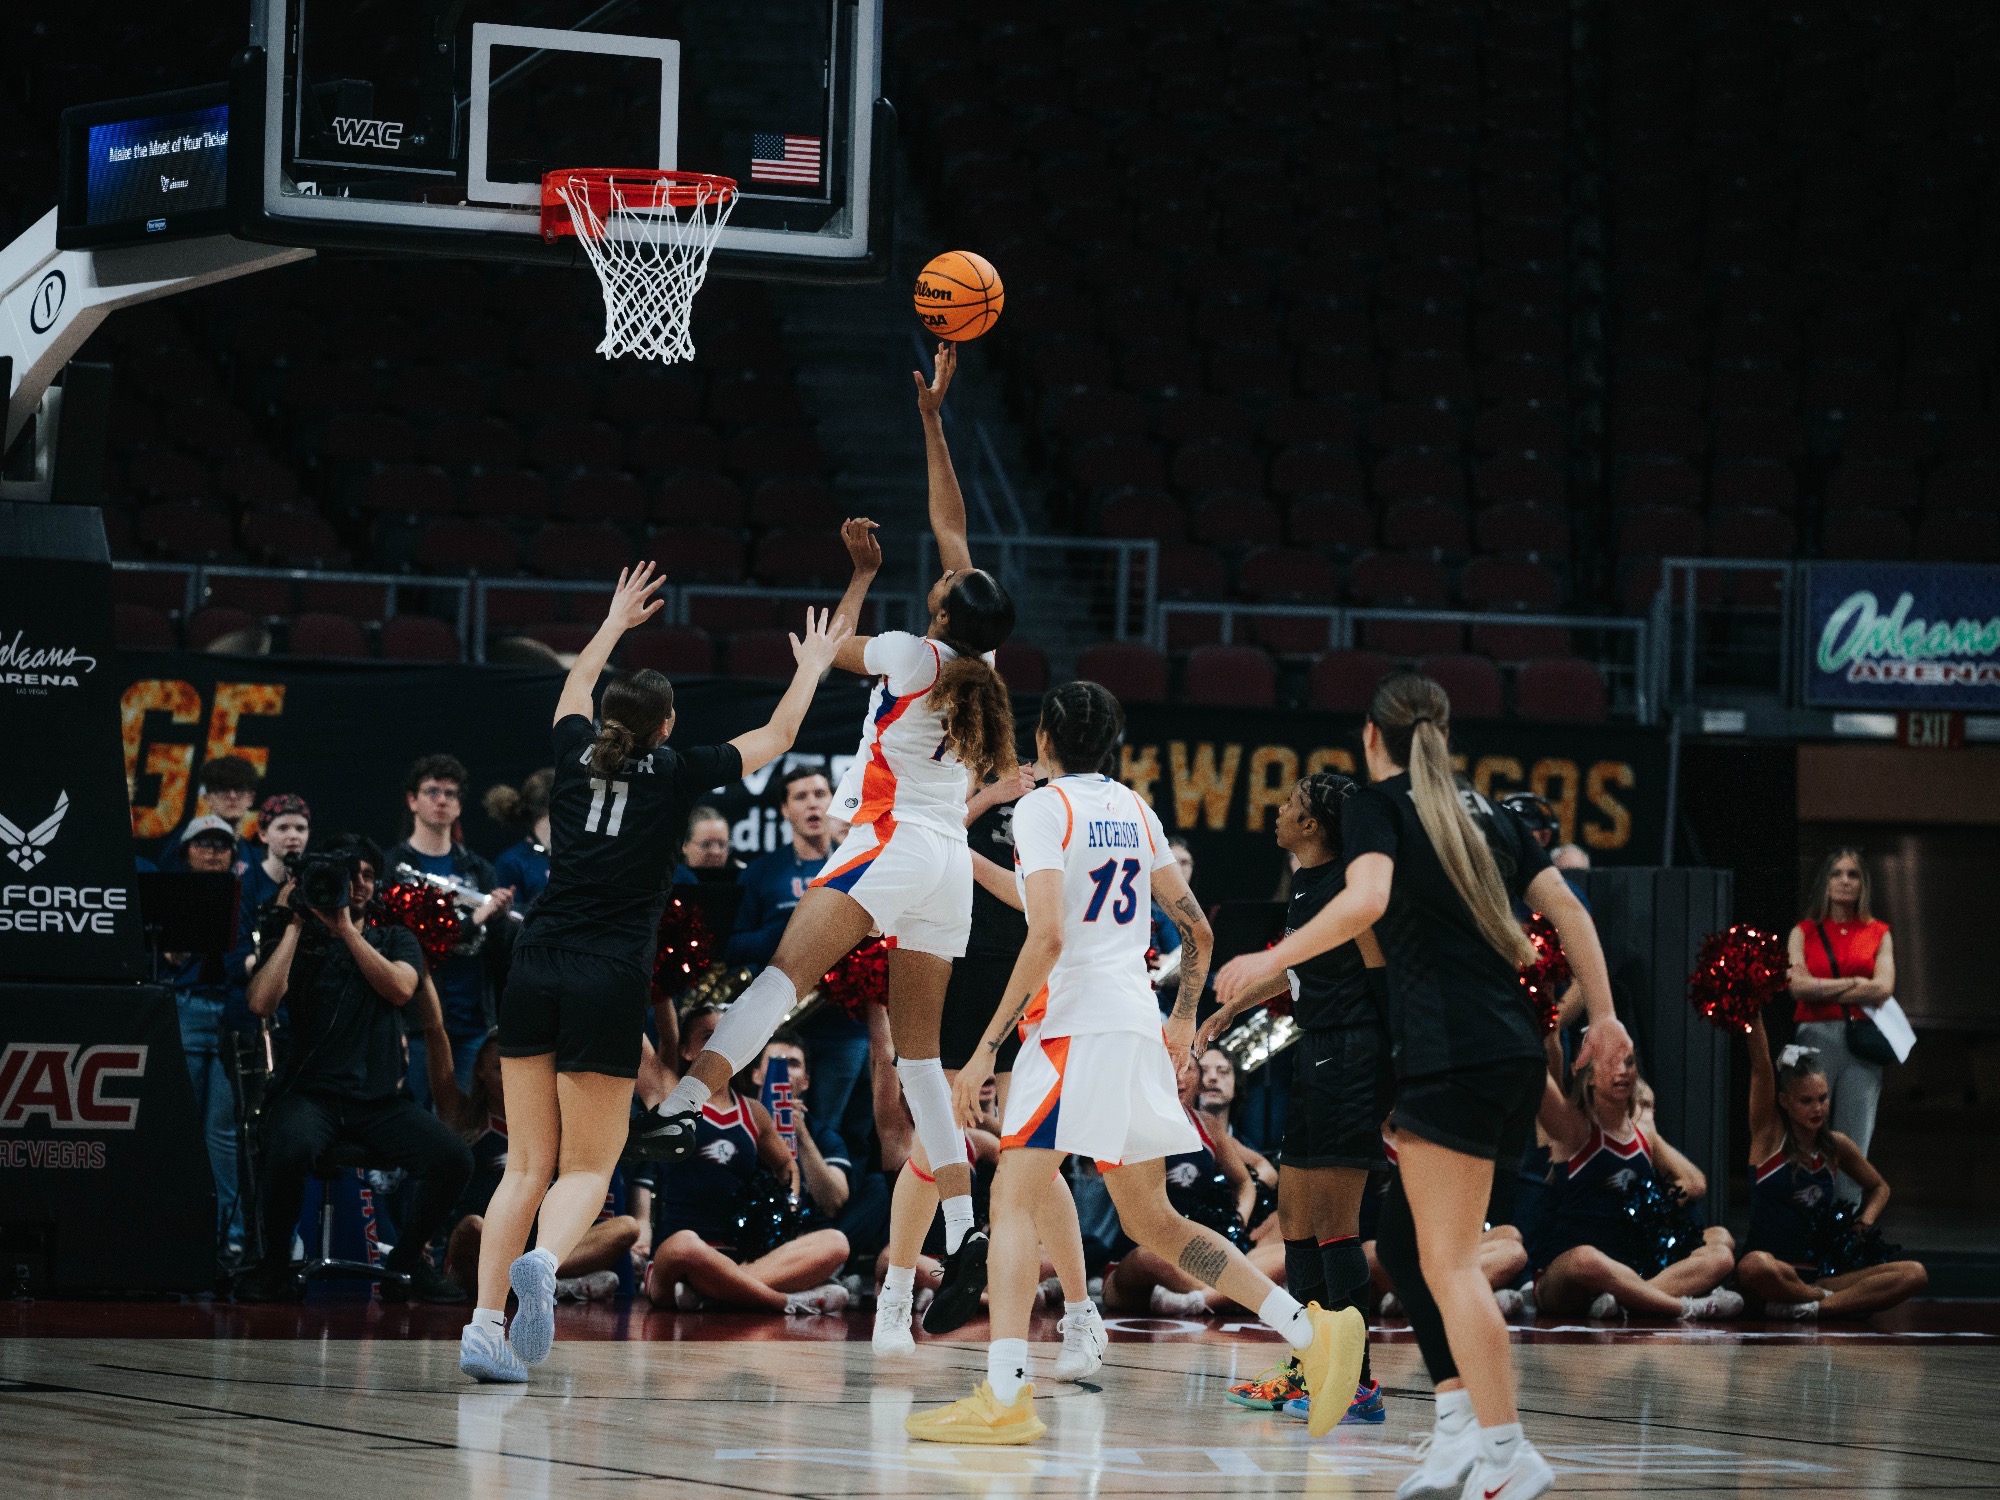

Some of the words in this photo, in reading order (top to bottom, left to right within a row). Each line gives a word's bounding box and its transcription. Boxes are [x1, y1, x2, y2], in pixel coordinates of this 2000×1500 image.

[133, 142, 147, 158] the
[149, 140, 170, 156] Most
[171, 136, 181, 152] of
[183, 134, 202, 151] Your
[332, 116, 403, 149] WAC
[917, 312, 949, 326] CAA
[0, 629, 97, 673] rleans
[1847, 658, 2000, 687] ARENA
[28, 688, 48, 696] VEGAS
[1907, 712, 1950, 747] EXIT
[584, 777, 629, 837] 11
[1088, 820, 1140, 849] ATCHISON
[3, 884, 127, 910] FORCE
[1082, 858, 1142, 925] 13
